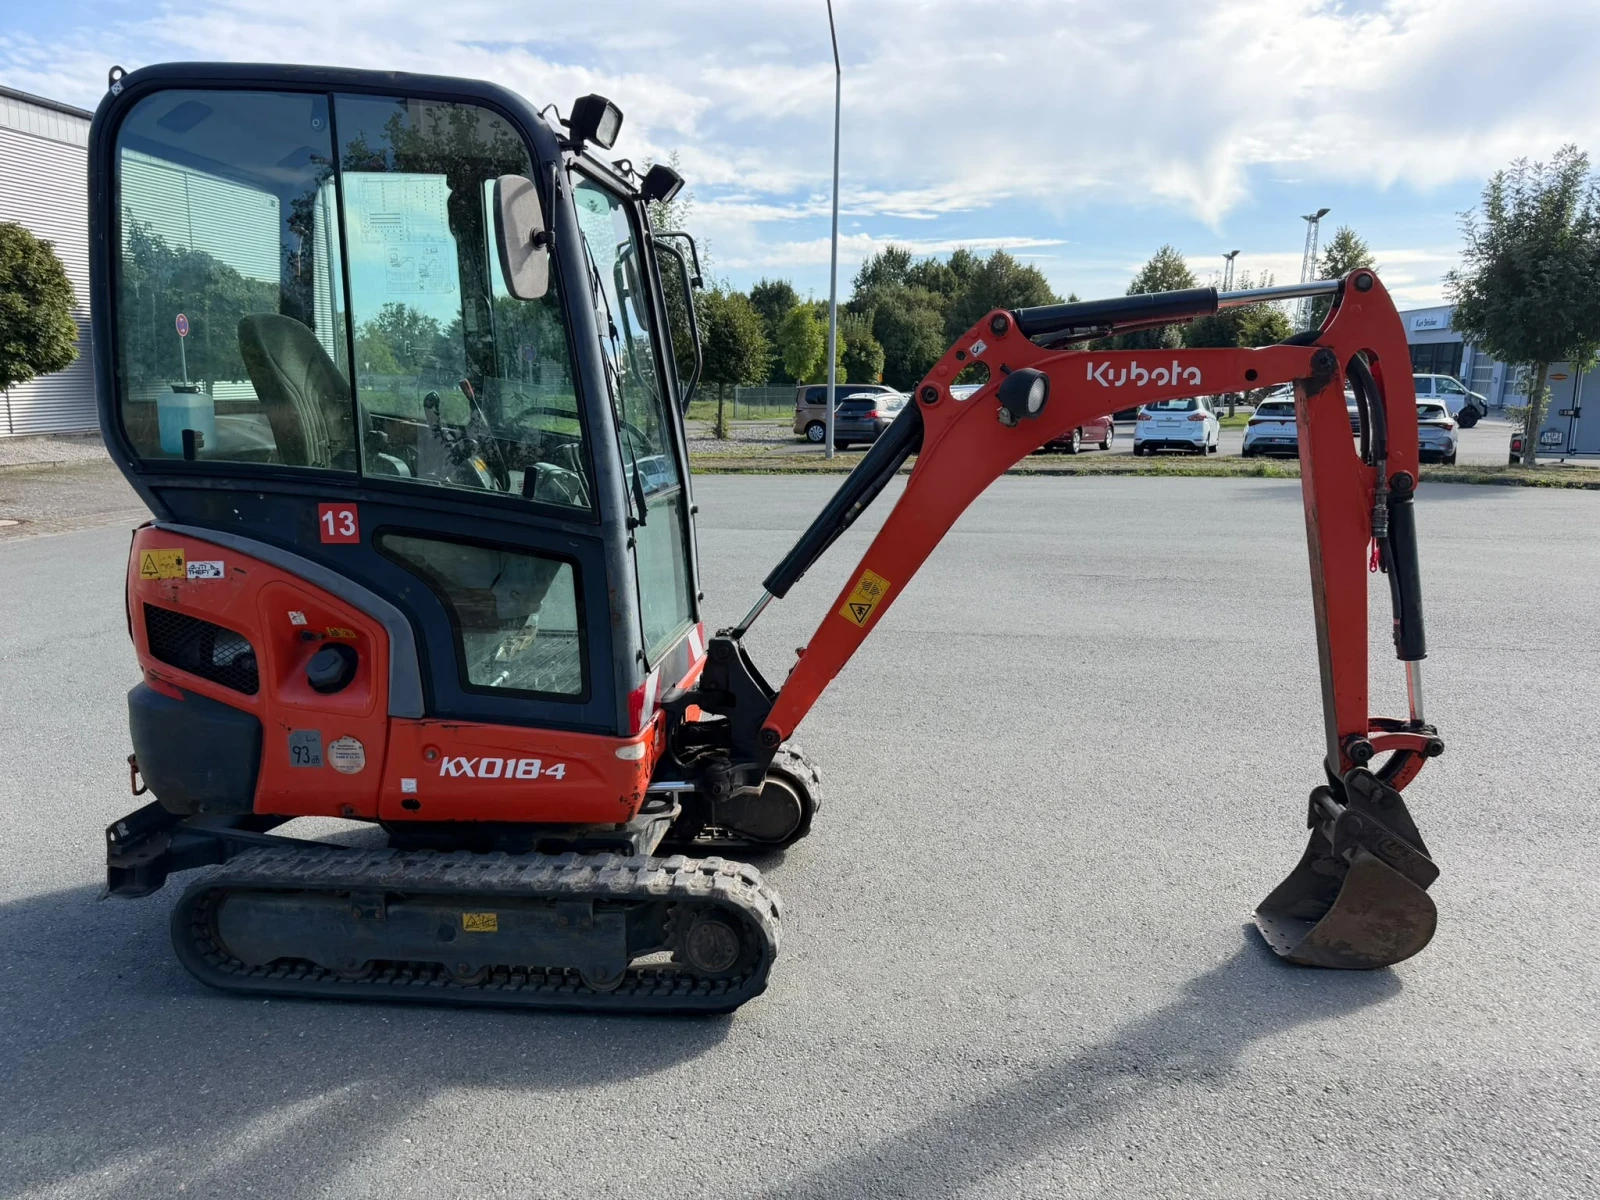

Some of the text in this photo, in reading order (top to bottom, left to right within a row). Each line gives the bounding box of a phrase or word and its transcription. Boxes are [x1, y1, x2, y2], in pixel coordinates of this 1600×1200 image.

[1087, 360, 1202, 387] Kubota
[321, 509, 356, 538] 13
[292, 745, 320, 764] 93 dB
[439, 756, 566, 780] KX018-4
